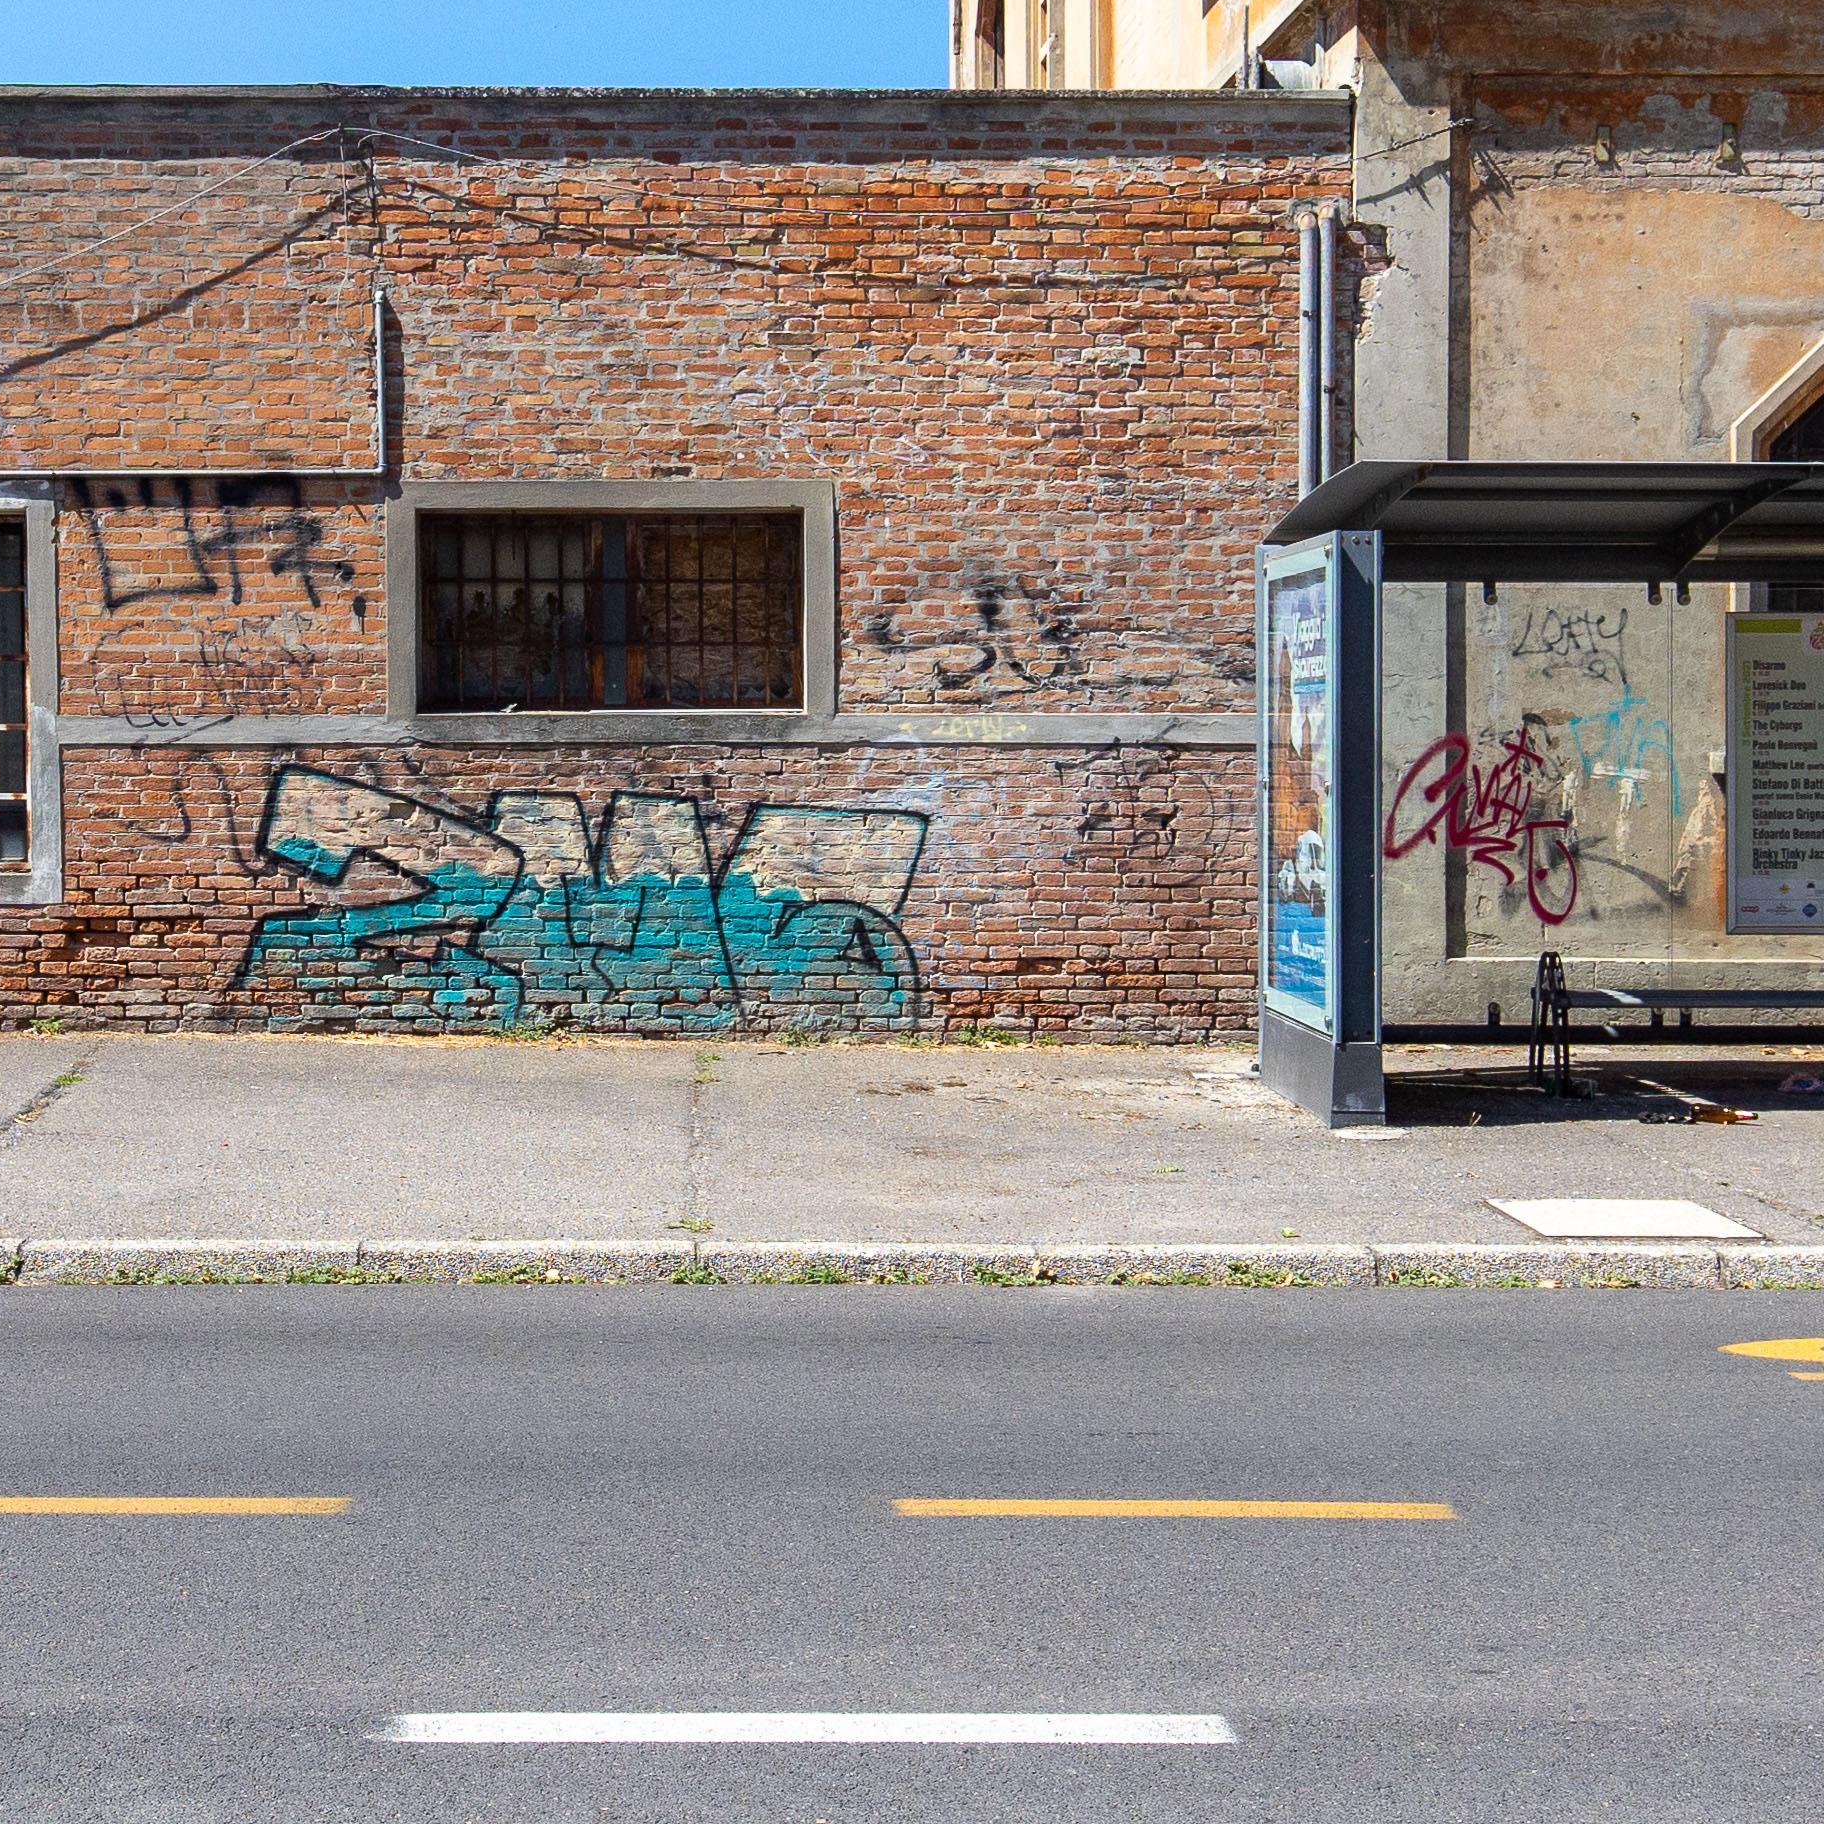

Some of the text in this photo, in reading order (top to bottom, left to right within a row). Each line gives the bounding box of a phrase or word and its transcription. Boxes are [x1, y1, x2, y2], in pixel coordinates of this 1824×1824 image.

[1752, 700, 1781, 712] Filippo
[1752, 720, 1803, 732] The Cyborgs
[1752, 760, 1788, 770] Matthew
[1790, 760, 1805, 770] Lee
[1752, 778, 1790, 790] Stefano
[1791, 778, 1801, 790] Di
[1752, 808, 1794, 820] Gianluca
[1752, 828, 1790, 840] Edoardo
[1752, 859, 1798, 870] Orchestra
